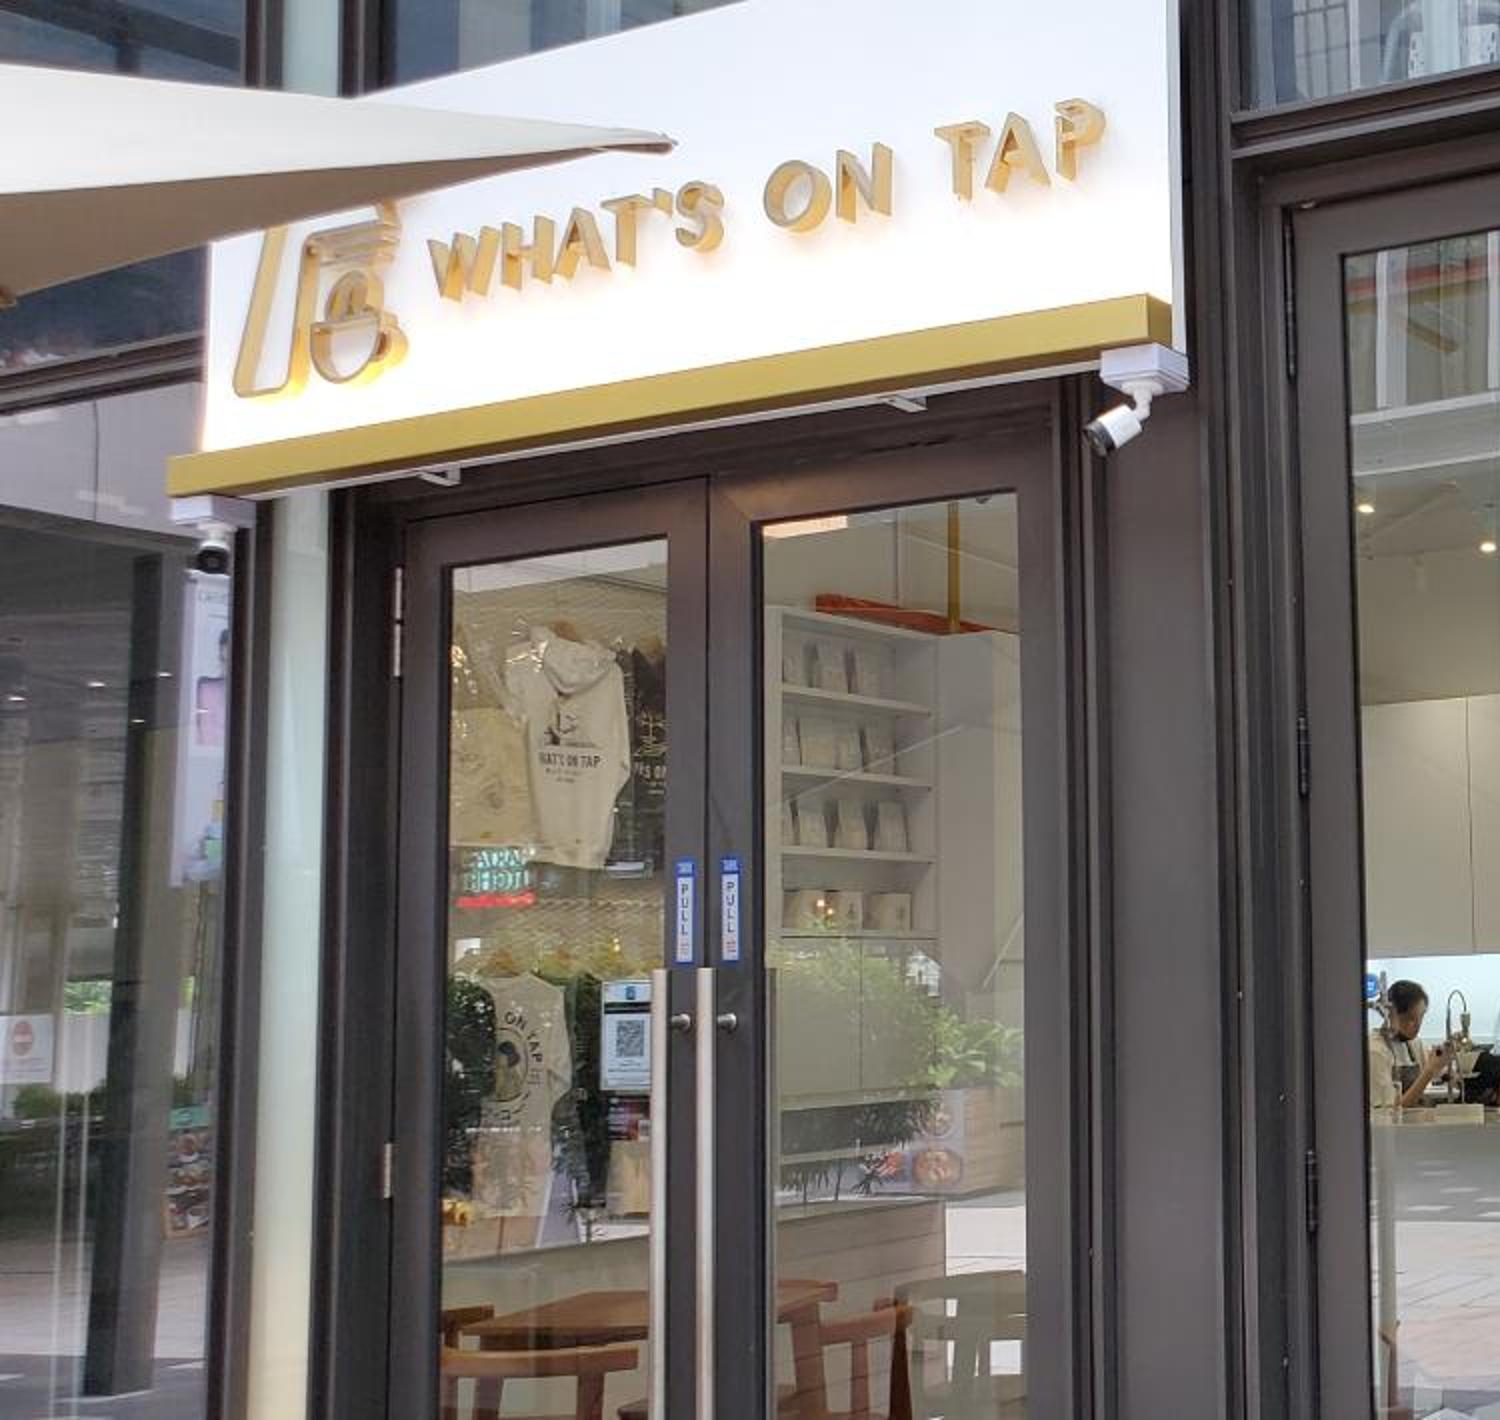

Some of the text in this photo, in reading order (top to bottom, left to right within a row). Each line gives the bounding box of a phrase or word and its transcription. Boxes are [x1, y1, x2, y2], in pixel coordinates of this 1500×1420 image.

[426, 97, 1106, 302] WHAT'S ON TAP
[681, 883, 689, 936] PULL
[726, 880, 735, 934] PULL
[504, 1010, 527, 1031] ON
